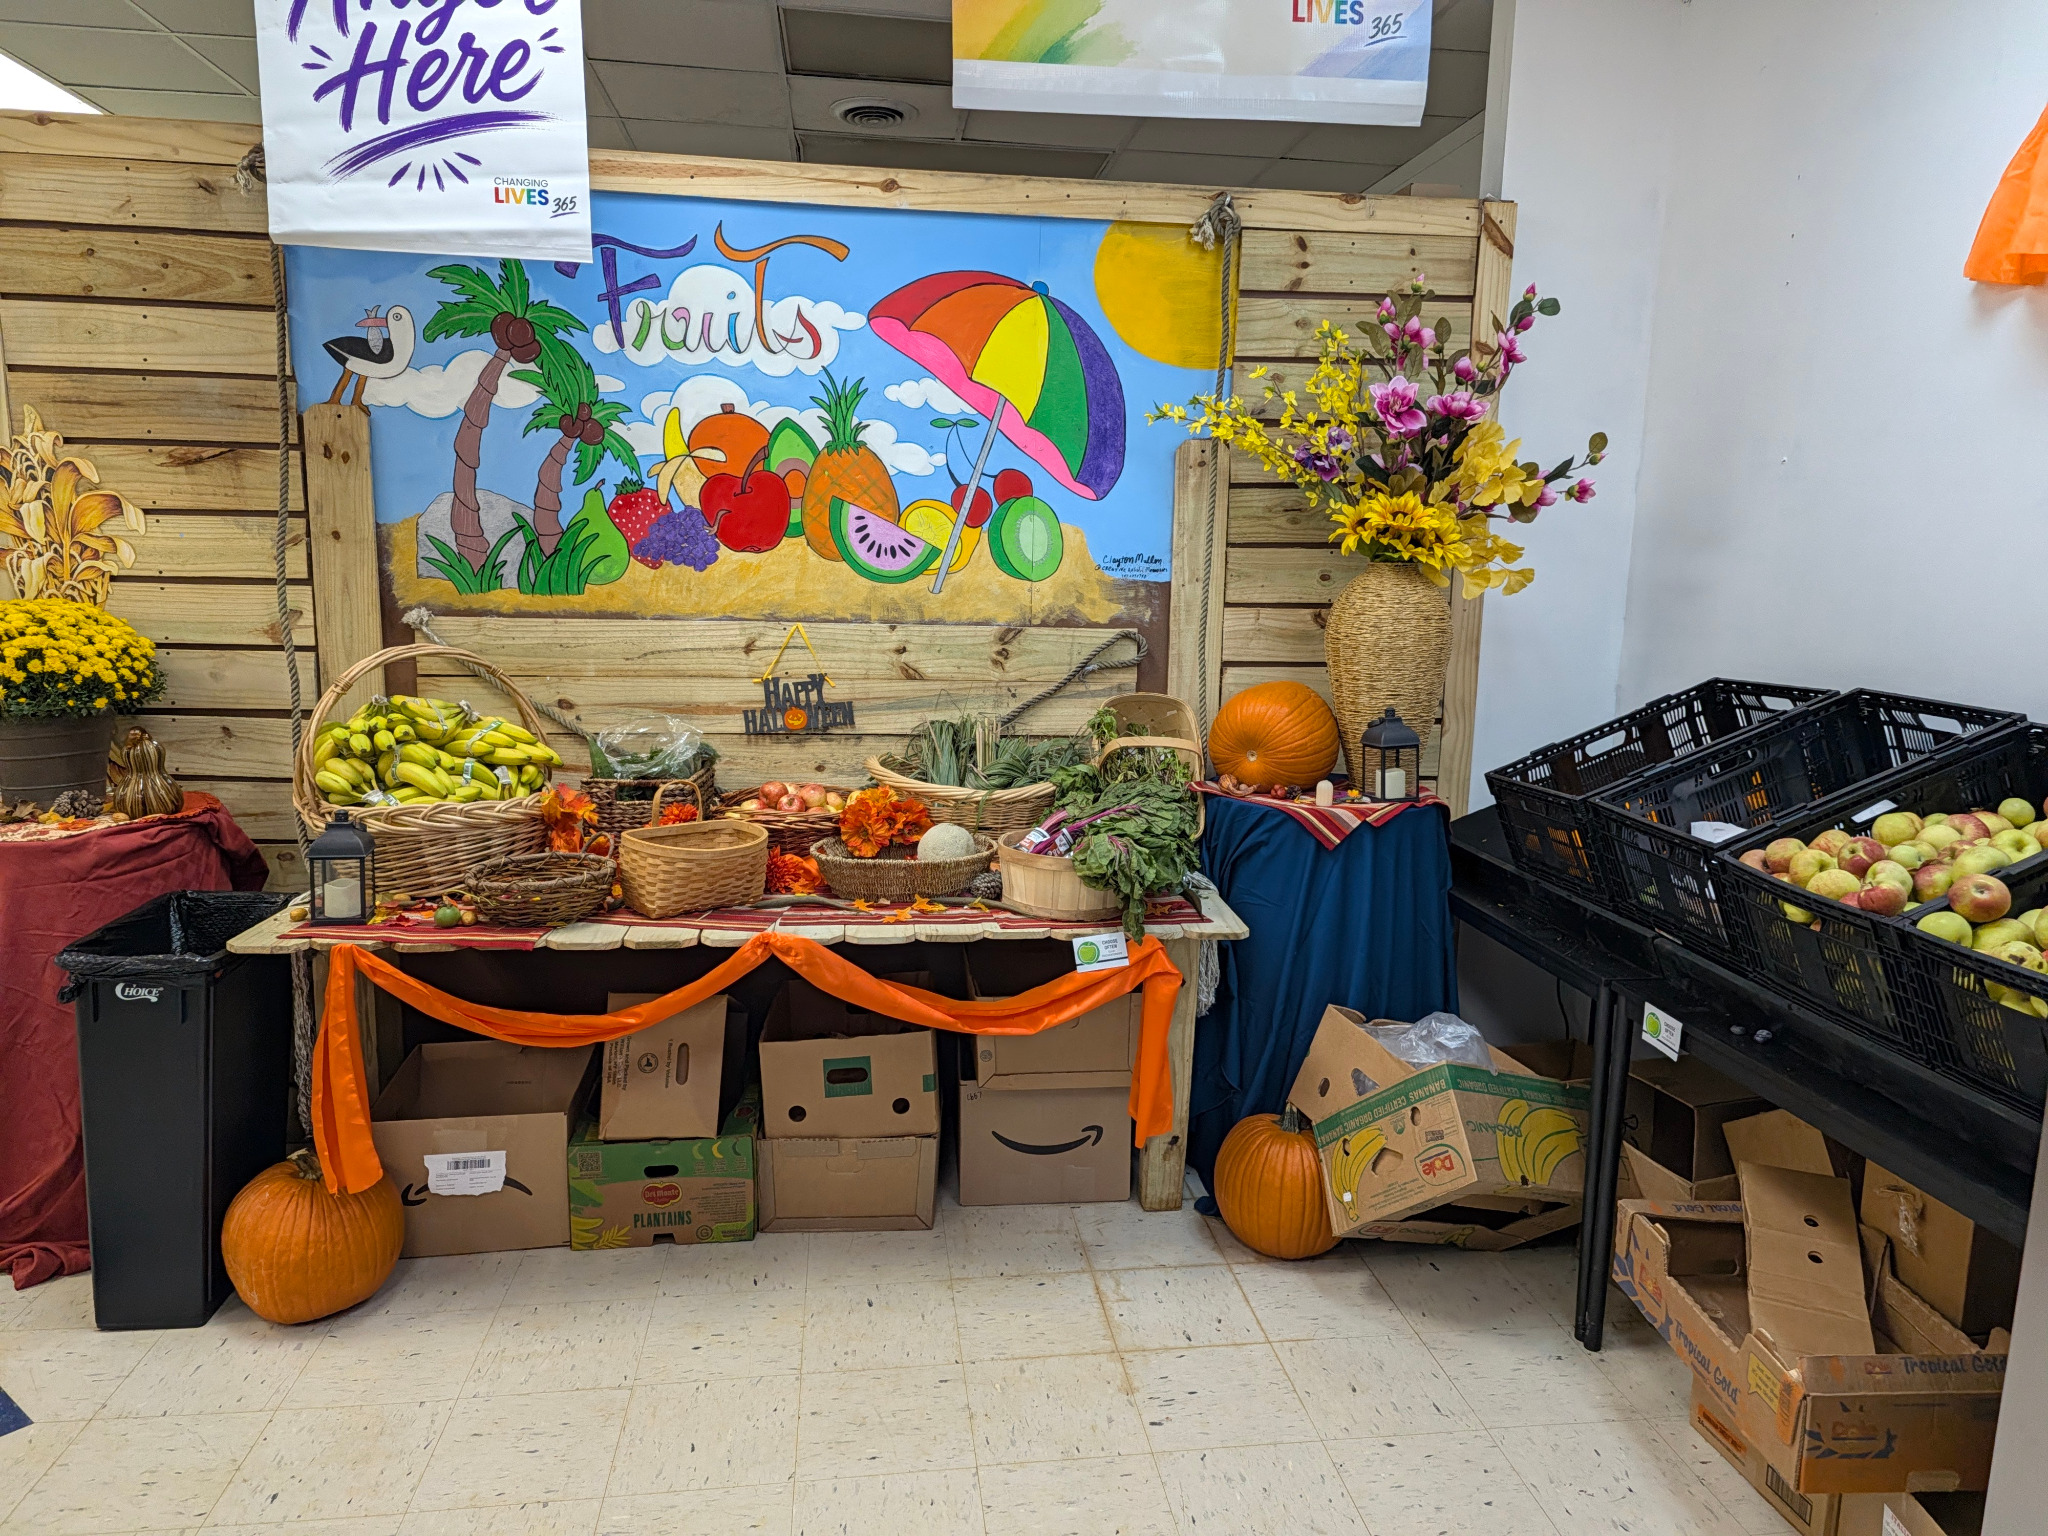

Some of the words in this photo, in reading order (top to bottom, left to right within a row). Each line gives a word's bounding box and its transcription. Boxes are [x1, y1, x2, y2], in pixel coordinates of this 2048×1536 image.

[1292, 0, 1364, 25] LIVES
[1368, 12, 1403, 39] 365
[313, 19, 545, 133] Here
[494, 177, 549, 187] CHANGING
[494, 187, 549, 206] LIVES
[552, 195, 577, 214] 365
[592, 220, 849, 360] Fruits
[763, 673, 827, 709] HAPPY
[115, 982, 159, 1002] CHOICE
[1409, 1078, 1447, 1102] BANANAS
[1458, 1079, 1488, 1093] ORGANIC
[1487, 1083, 1519, 1097] CERTIFIED
[1373, 1096, 1407, 1119] CERTIFIED
[1344, 1113, 1373, 1131] ORGANIC
[1466, 1120, 1522, 1138] ORGANIC
[1422, 1154, 1454, 1178] Dole
[644, 1189, 656, 1198] Del
[656, 1188, 680, 1198] Monte
[633, 1210, 692, 1229] PLANTAINS
[1675, 1318, 1711, 1374] Tropical
[1713, 1366, 1739, 1405] Gold
[1899, 1356, 1967, 1375] Tropical
